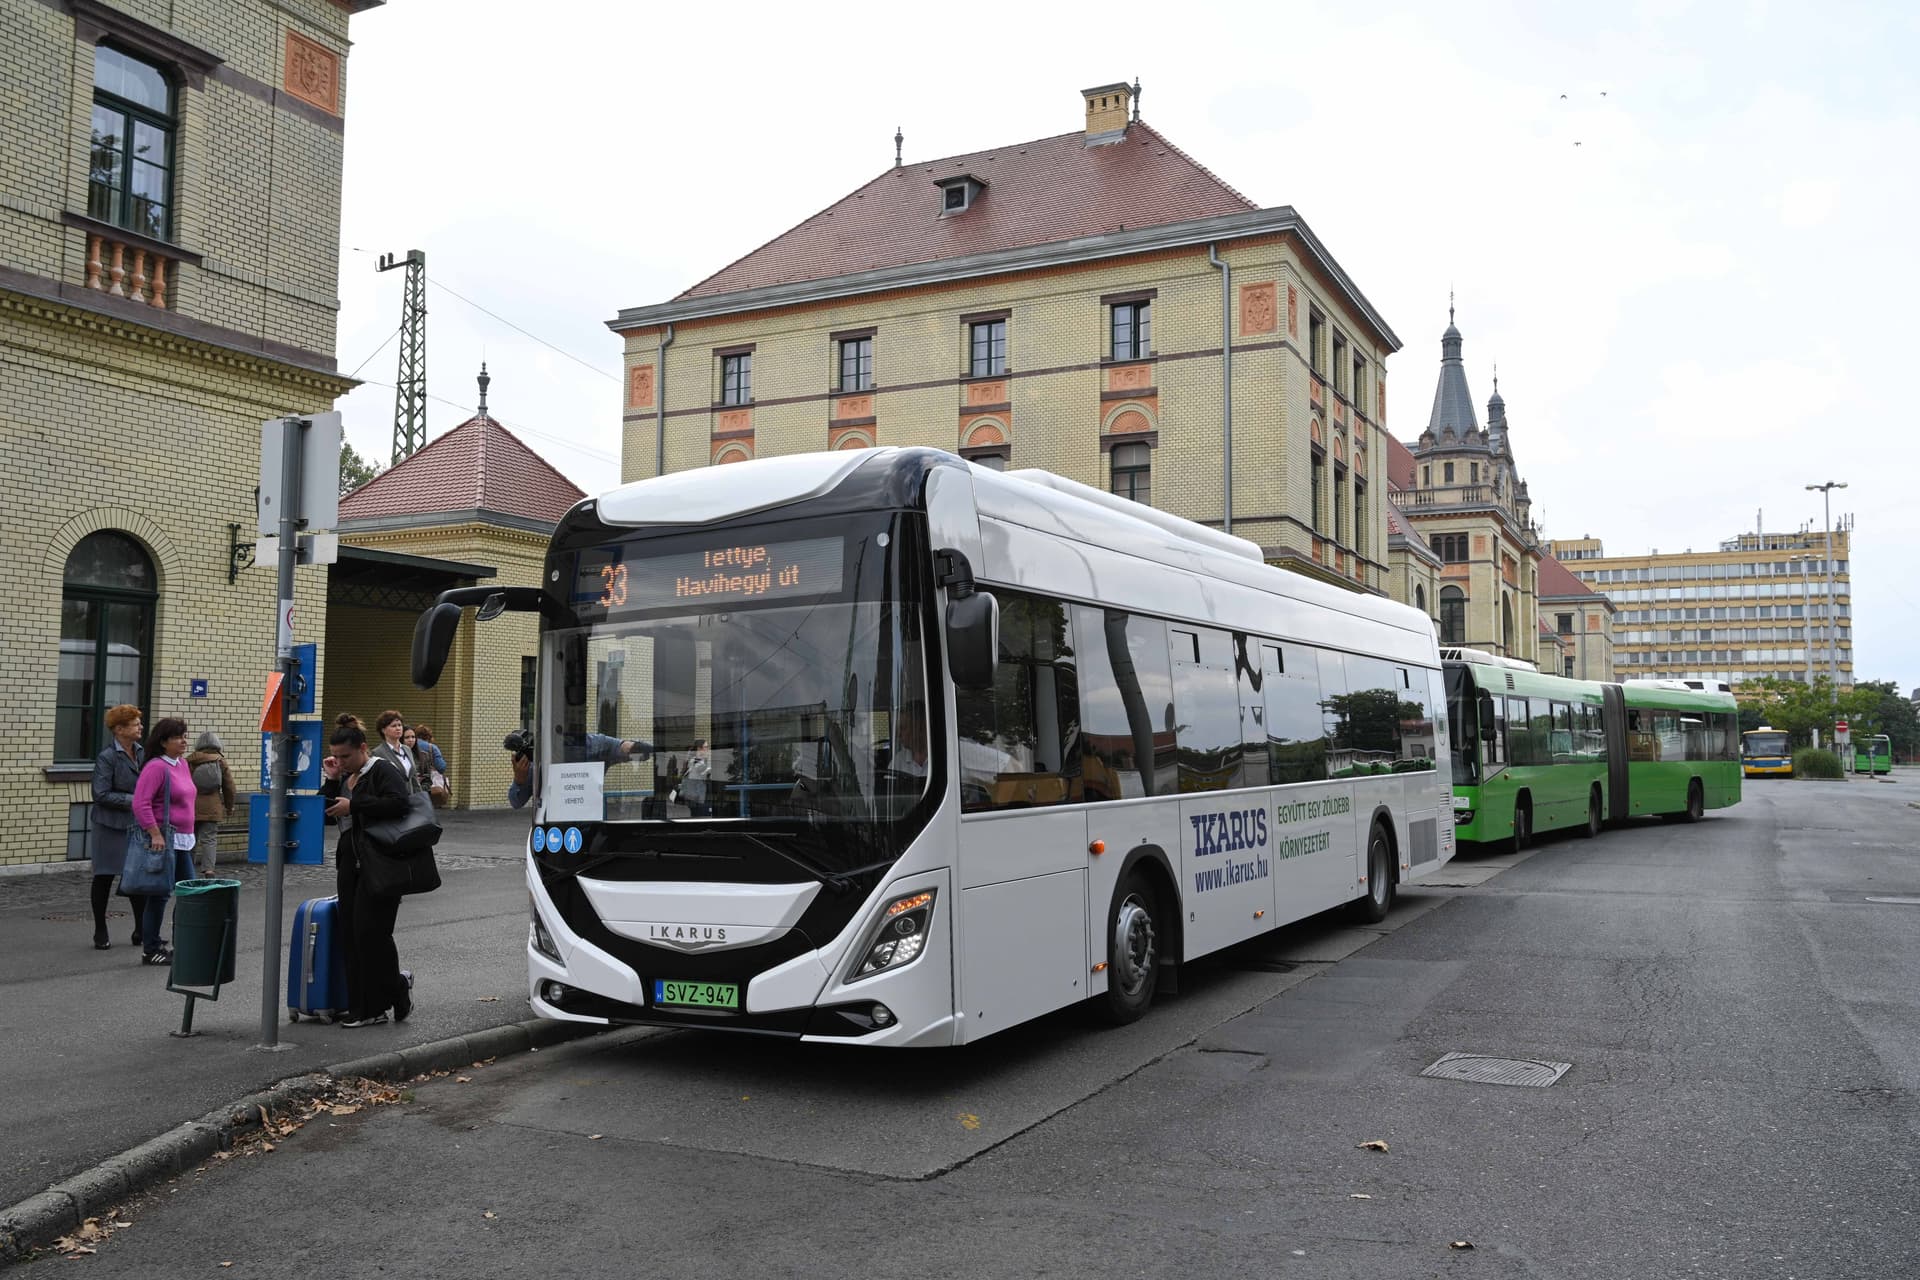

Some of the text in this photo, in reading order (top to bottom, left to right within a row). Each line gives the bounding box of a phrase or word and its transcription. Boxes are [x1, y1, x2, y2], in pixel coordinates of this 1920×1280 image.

[601, 563, 629, 607] 33
[675, 564, 800, 596] Havihegyi út
[1278, 800, 1306, 824] EGYÜTT
[1308, 800, 1321, 819] EGY
[1190, 808, 1267, 857] IKARUS
[1279, 829, 1330, 861] KÖRNYEZETÉRT
[1195, 854, 1268, 893] www.ikarus.hu
[650, 925, 726, 940] IKARUS
[666, 983, 734, 1005] SVZ-947
